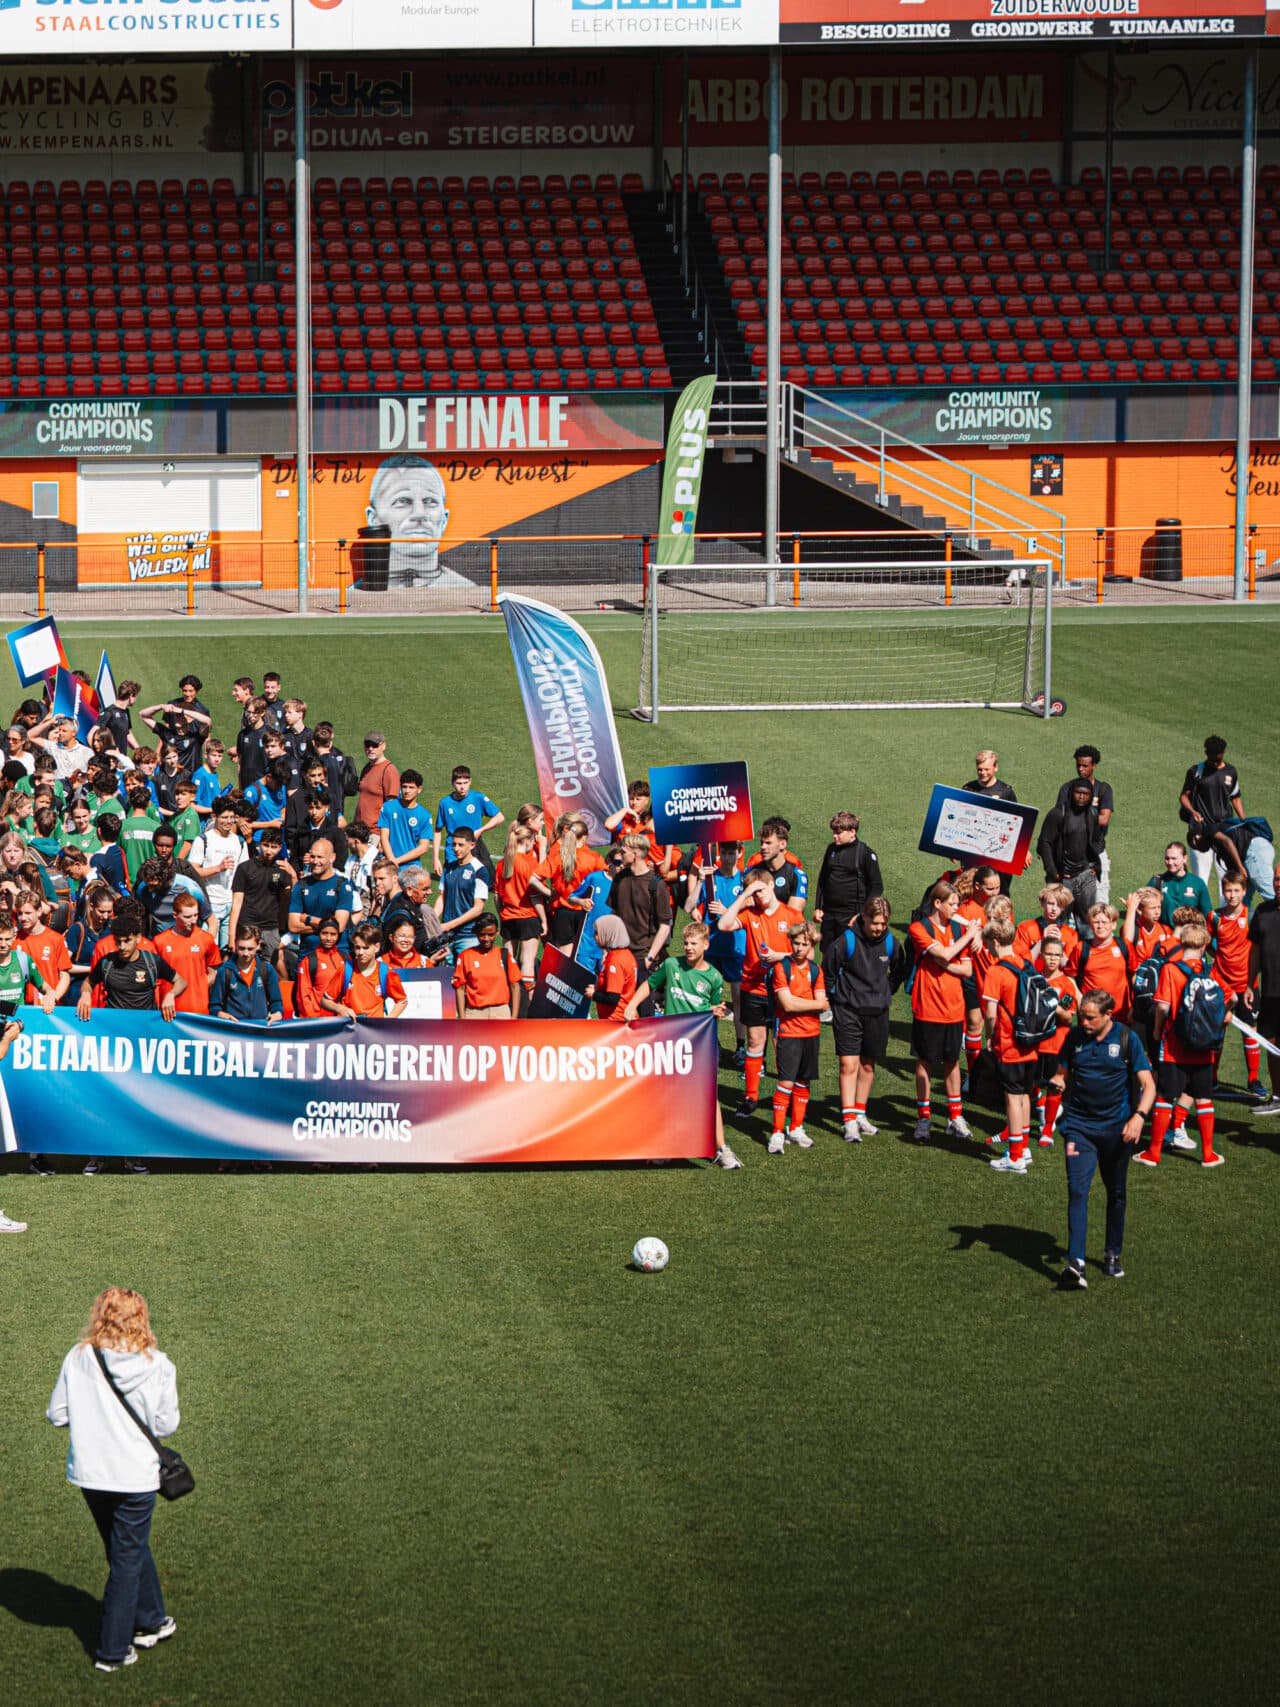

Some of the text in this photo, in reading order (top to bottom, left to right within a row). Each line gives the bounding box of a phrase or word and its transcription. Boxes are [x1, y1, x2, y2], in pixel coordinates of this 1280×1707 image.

[401, 4, 479, 15] Modular Europe
[35, 13, 280, 31] STAALCONSTRUCTIES
[571, 17, 743, 33] ELEKTROTECHNIEK
[820, 18, 1235, 40] BESCHOEIING GRONDWERK TUINAANLEG
[800, 74, 1045, 122] ROTTERDAM
[144, 111, 180, 128] B.V.
[447, 124, 636, 146] STEIGERBOUW
[948, 390, 1040, 407] COMMUNITY
[49, 402, 141, 419] COMMUNITY
[935, 407, 1052, 432] CHAMPIONS
[36, 418, 153, 443] CHAMPIONS
[379, 396, 569, 450] DE FINALE
[981, 432, 1031, 442] voorsprong
[58, 443, 132, 454] Jouw voorsprong
[674, 408, 707, 505] PLUS
[324, 459, 367, 485] Tol
[671, 785, 728, 800] COMMUNITY
[664, 796, 738, 816] CHAMPIONS
[13, 1033, 694, 1083] BETAALD VOETBAL ZET JONGEREN OP VOORSPRONG
[306, 1101, 400, 1119] COMMUNITY
[292, 1117, 412, 1142] CHAMPIONS
